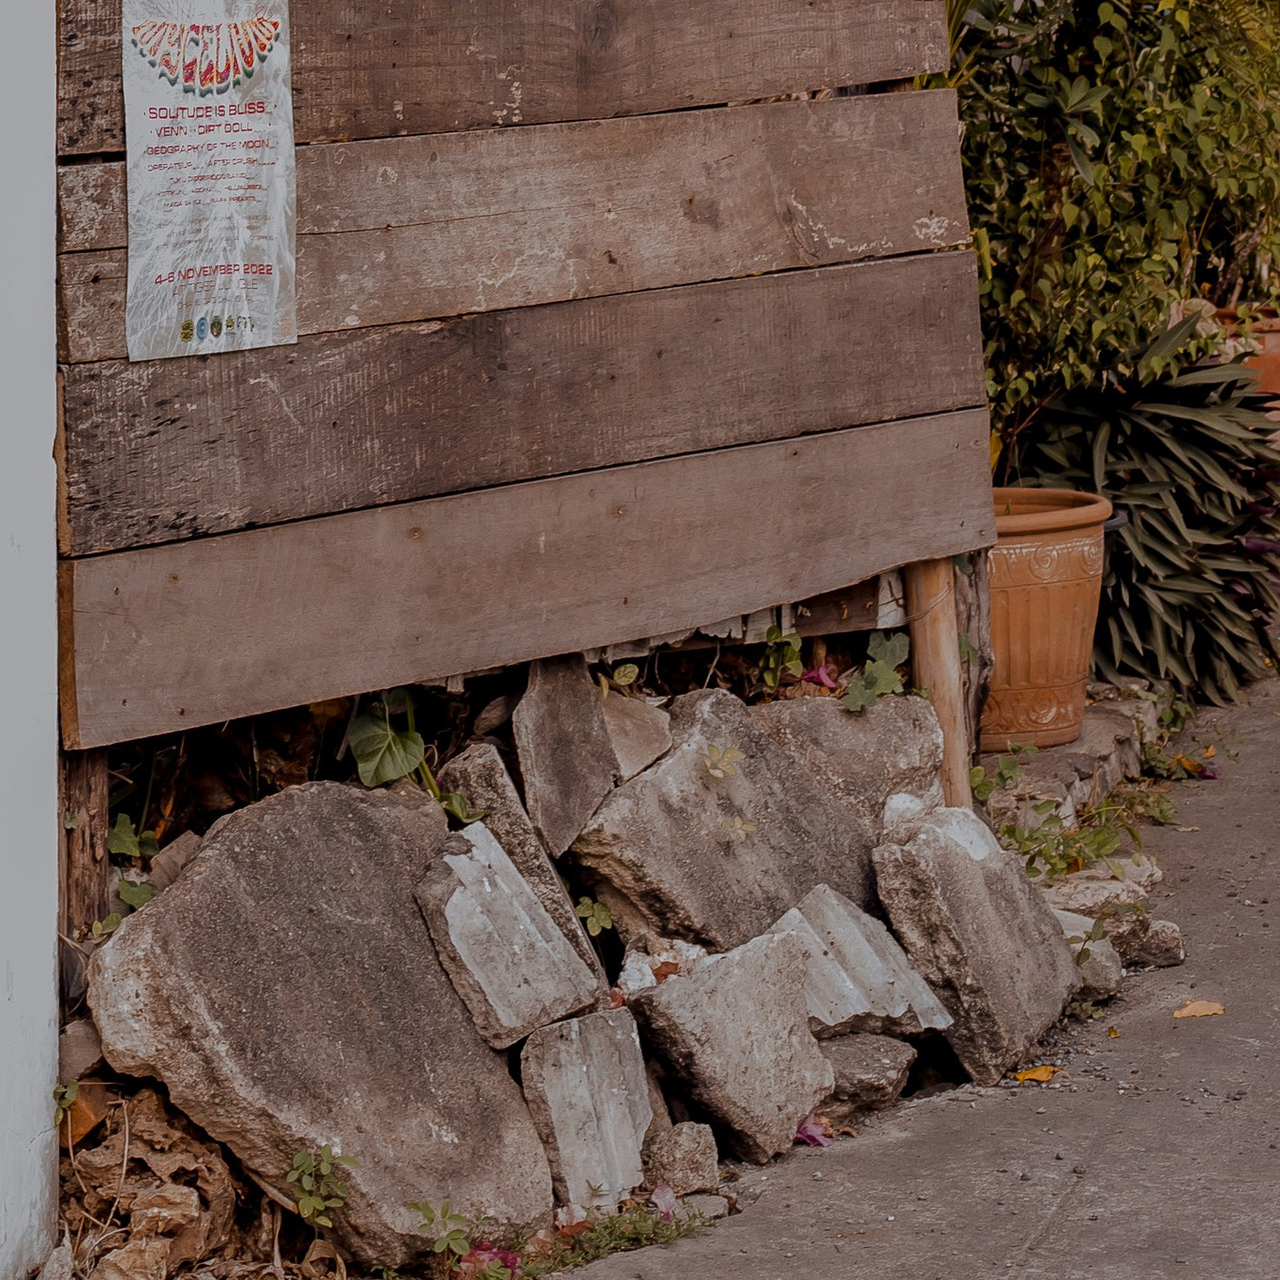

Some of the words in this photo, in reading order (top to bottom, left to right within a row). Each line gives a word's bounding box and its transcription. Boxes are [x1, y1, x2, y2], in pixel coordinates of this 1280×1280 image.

[148, 105, 213, 120] SOLITUDE
[214, 104, 226, 118] IS
[228, 101, 266, 116] BLISS
[155, 125, 188, 138] VENN
[197, 123, 222, 136] DIRT
[224, 121, 254, 133] DOLL
[239, 139, 270, 150] MOON
[154, 271, 176, 286] 4-6
[177, 263, 240, 281] NOVEMBER
[242, 263, 274, 275] 2022
